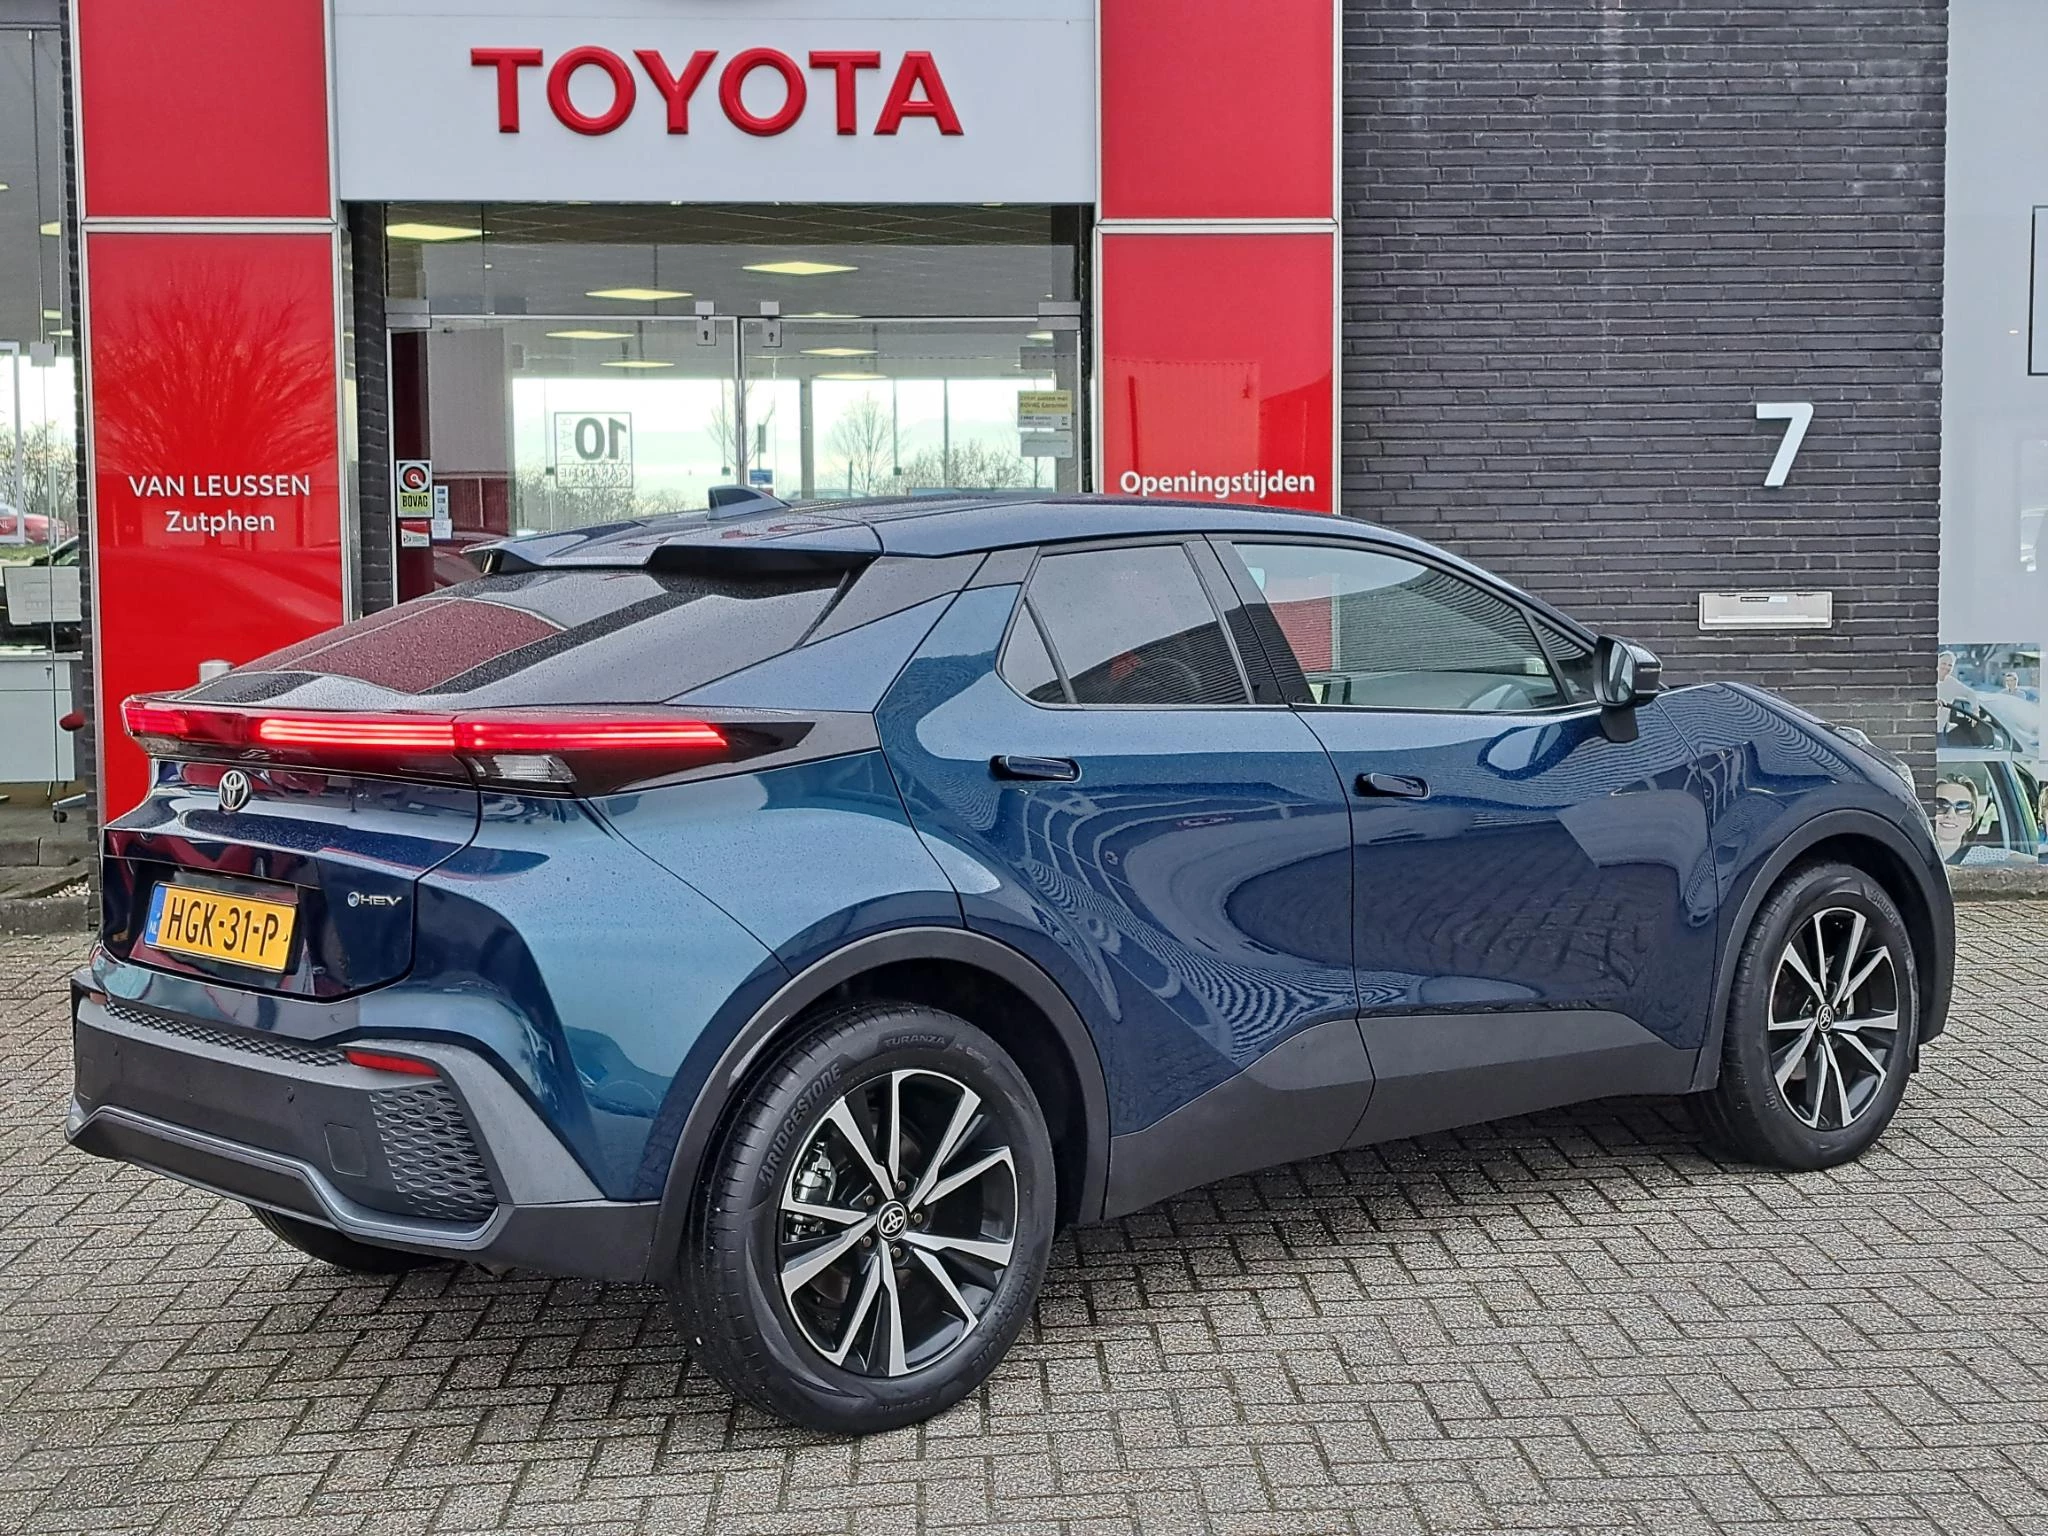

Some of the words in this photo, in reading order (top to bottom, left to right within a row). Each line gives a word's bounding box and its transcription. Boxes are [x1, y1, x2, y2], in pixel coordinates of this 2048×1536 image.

[470, 45, 964, 136] TOYOTA
[1756, 402, 1814, 486] 7
[128, 475, 185, 497] VAN
[193, 475, 310, 497] LEUSSEN
[1120, 469, 1315, 498] Openingstijden
[165, 509, 275, 537] Zutphen
[360, 895, 402, 906] HEV
[166, 896, 279, 956] HGK-31-P
[758, 1062, 842, 1187] BRIDGESTONE
